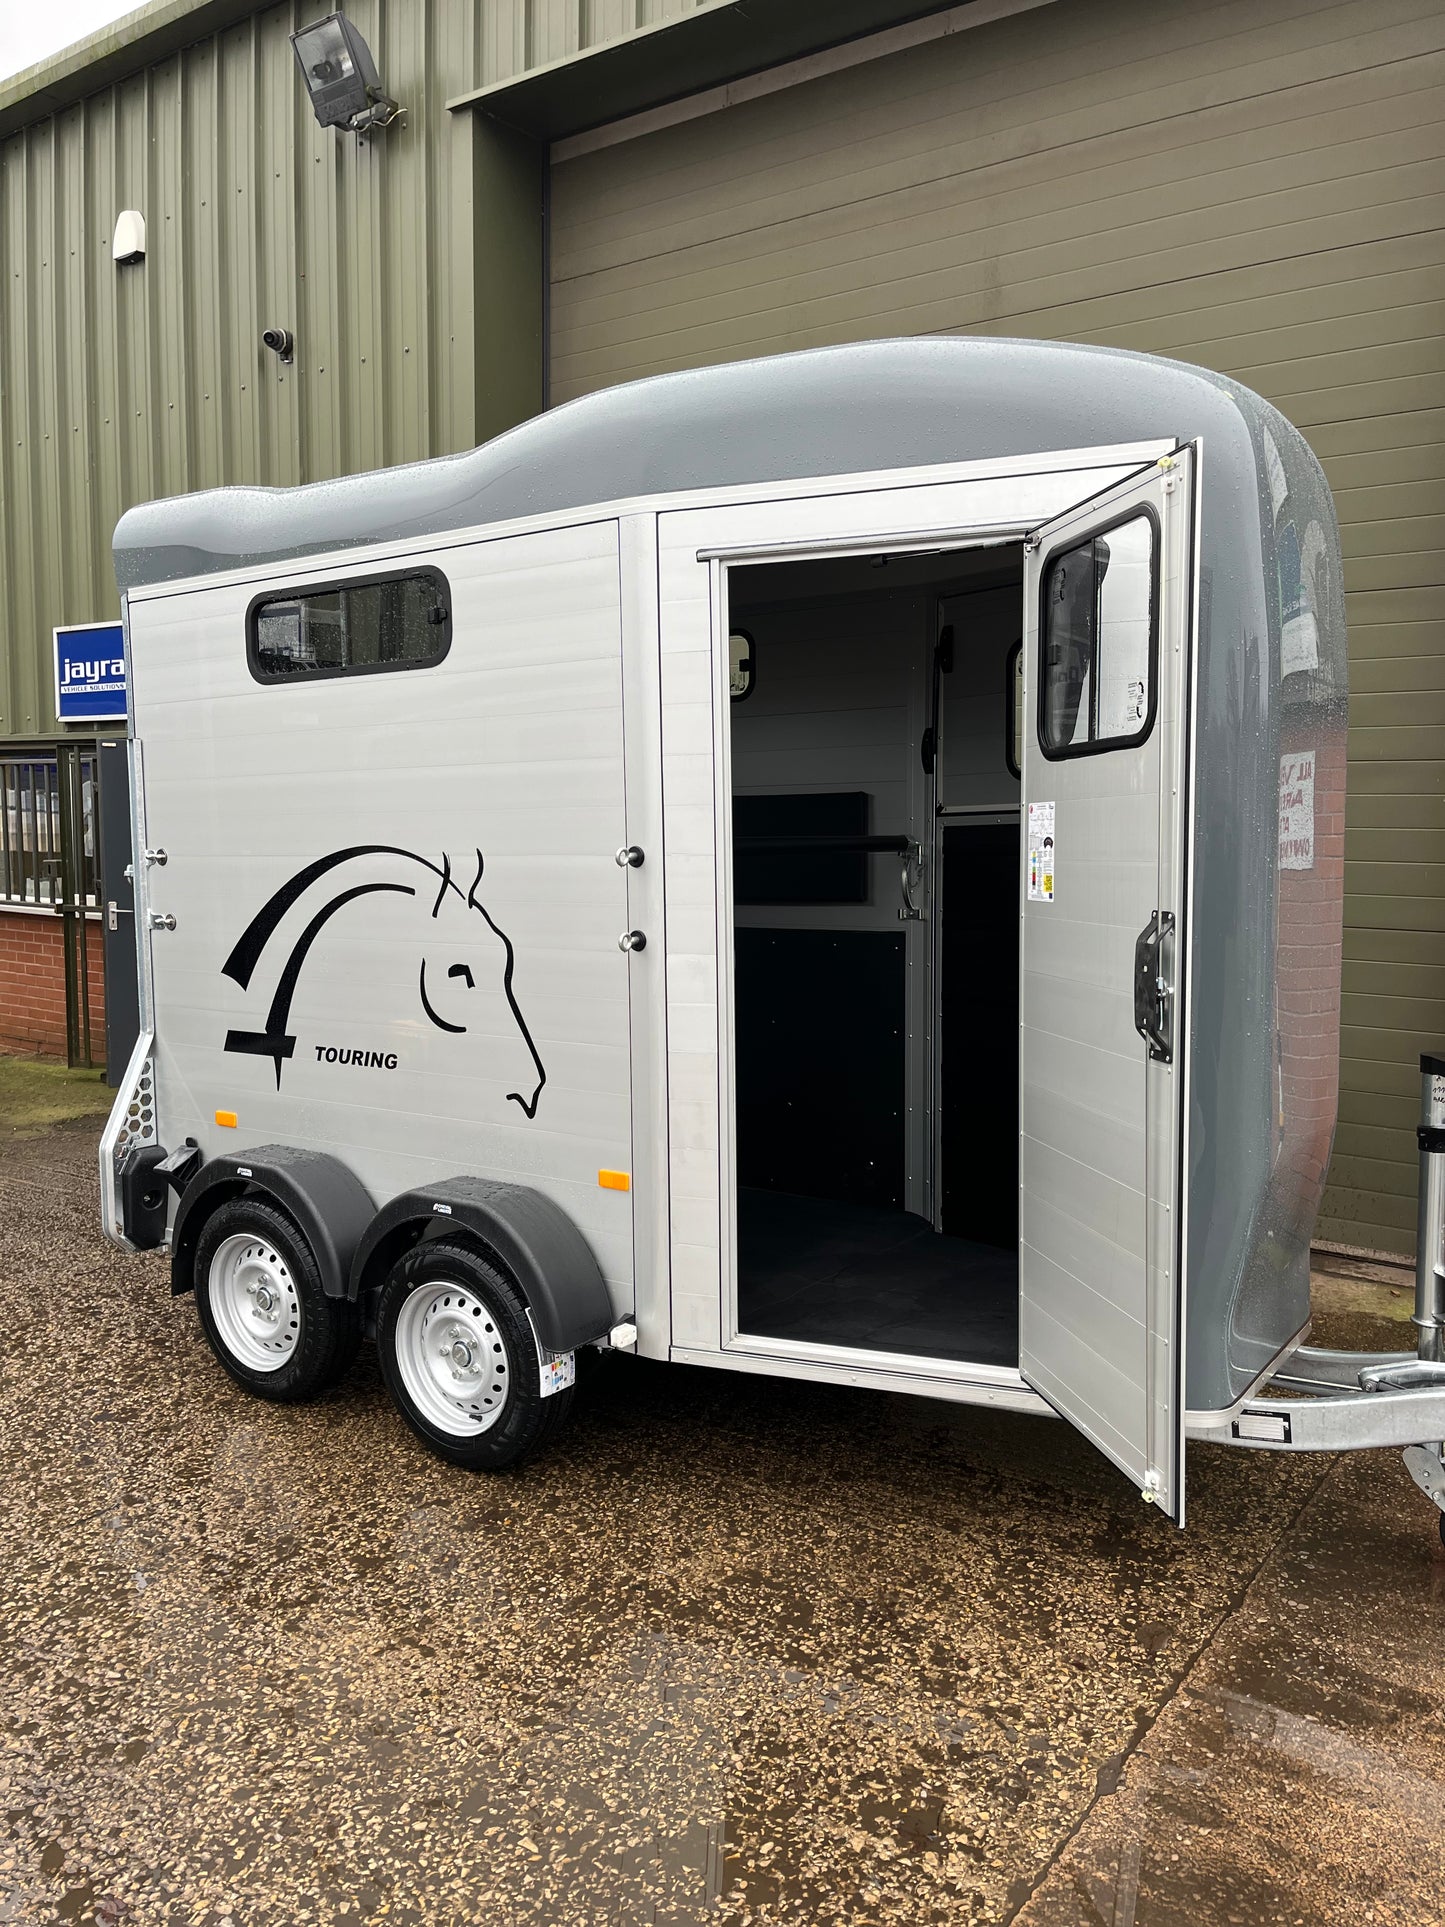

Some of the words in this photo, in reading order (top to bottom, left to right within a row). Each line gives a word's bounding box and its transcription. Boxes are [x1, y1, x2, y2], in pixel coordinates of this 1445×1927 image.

[61, 658, 125, 685] jayra
[89, 683, 125, 691] SOLUTIONS
[315, 1046, 398, 1070] TOURING
